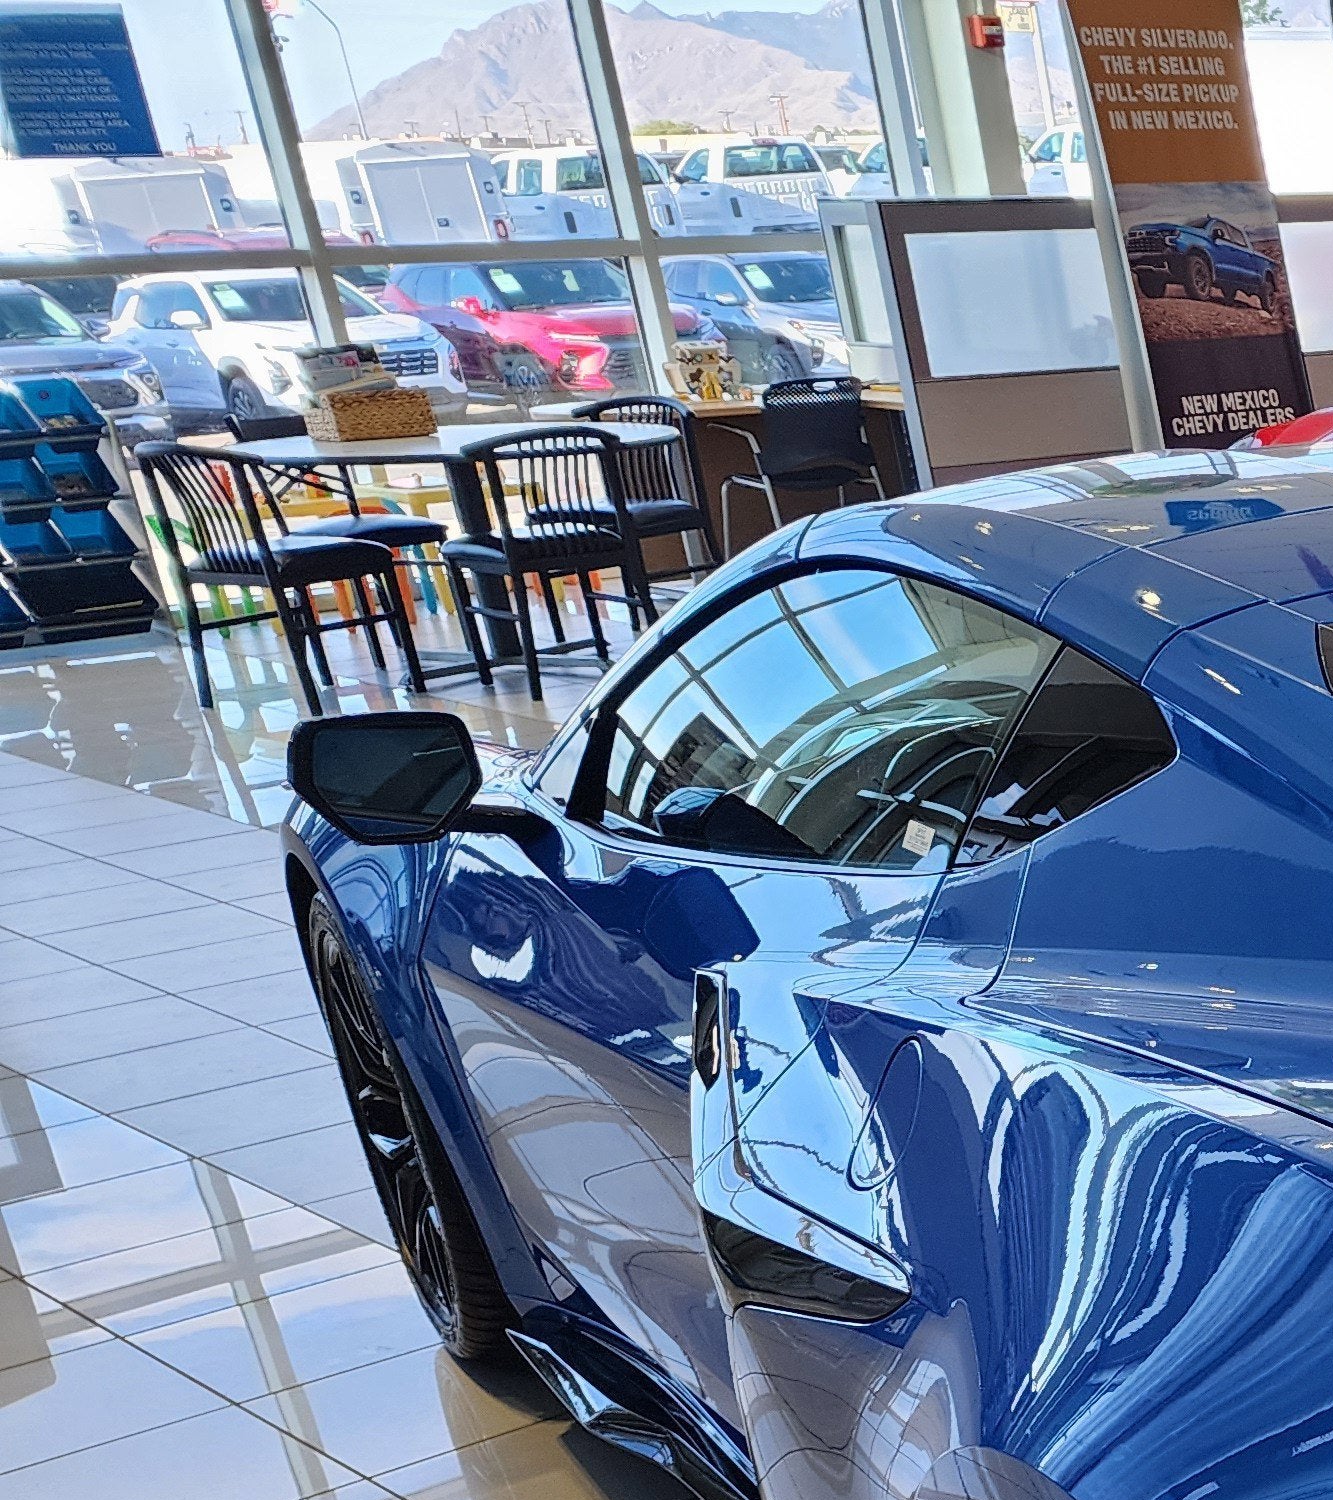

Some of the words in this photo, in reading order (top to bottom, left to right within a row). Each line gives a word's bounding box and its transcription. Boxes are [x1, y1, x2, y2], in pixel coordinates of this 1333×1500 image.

[1079, 26, 1136, 48] CHEVY
[1140, 27, 1235, 50] SILVERADO.
[1100, 55, 1132, 75] THE
[1136, 56, 1156, 75] #1
[1158, 56, 1226, 76] SELLING
[1092, 82, 1181, 103] FULL-SIZE
[1183, 83, 1240, 103] PICKUP
[1108, 110, 1129, 130] IN
[1130, 110, 1169, 131] NEW
[1171, 110, 1240, 130] MEXICO.
[52, 143, 92, 152] THANK
[92, 143, 117, 151] YOU
[1181, 393, 1218, 415] NEW
[1221, 388, 1280, 411] MEXICO
[1172, 413, 1224, 437] CHEVY
[1228, 407, 1296, 431] DEALERS
